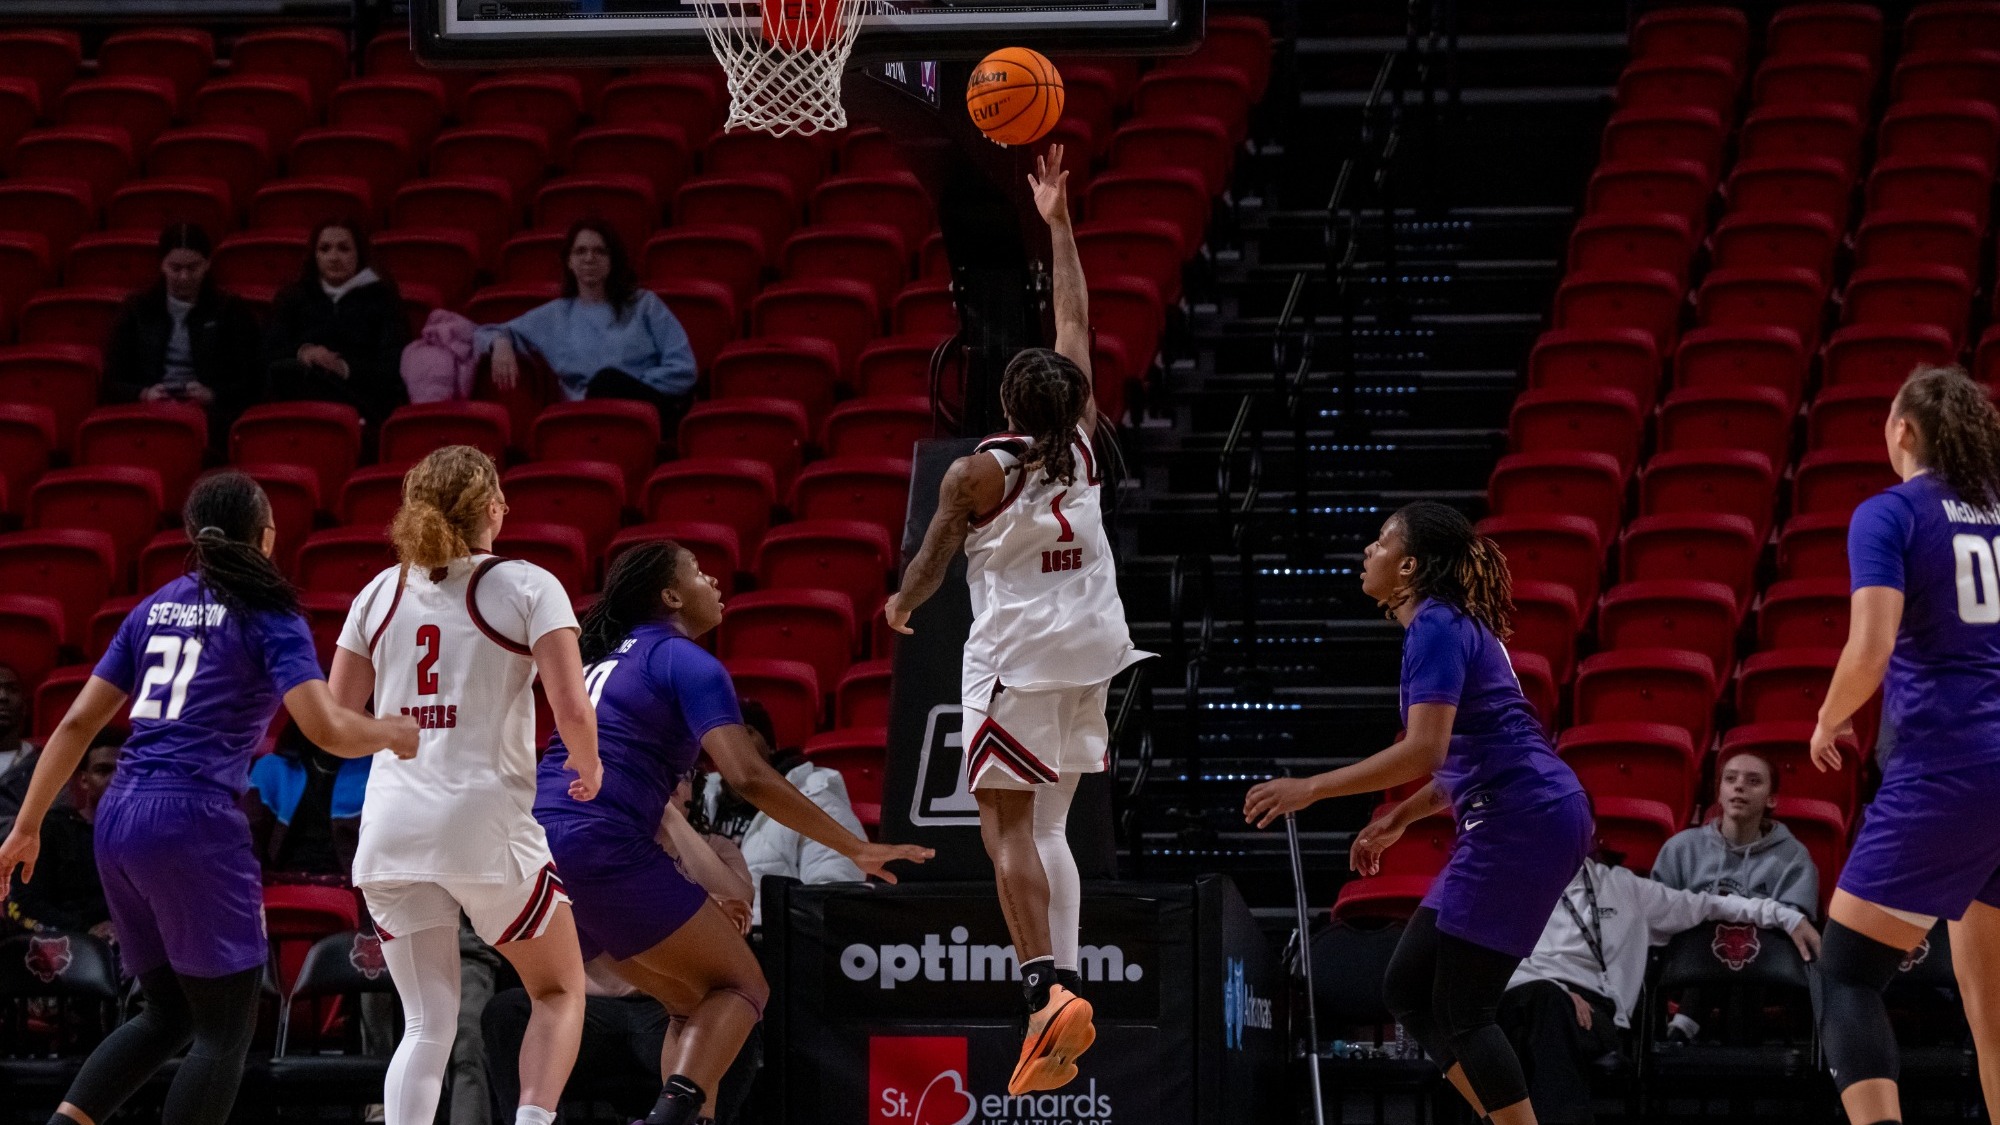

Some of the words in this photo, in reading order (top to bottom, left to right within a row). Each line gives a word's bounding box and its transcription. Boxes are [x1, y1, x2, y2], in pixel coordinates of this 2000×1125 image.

[1049, 489, 1074, 542] 1
[1941, 499, 2000, 525] McDANI
[1041, 548, 1083, 573] ROSE
[1952, 533, 2000, 623] 0
[129, 635, 203, 720] 21
[416, 624, 440, 695] 2
[582, 660, 619, 711] 0
[840, 926, 1143, 989] optimm.
[881, 1087, 913, 1118] St.
